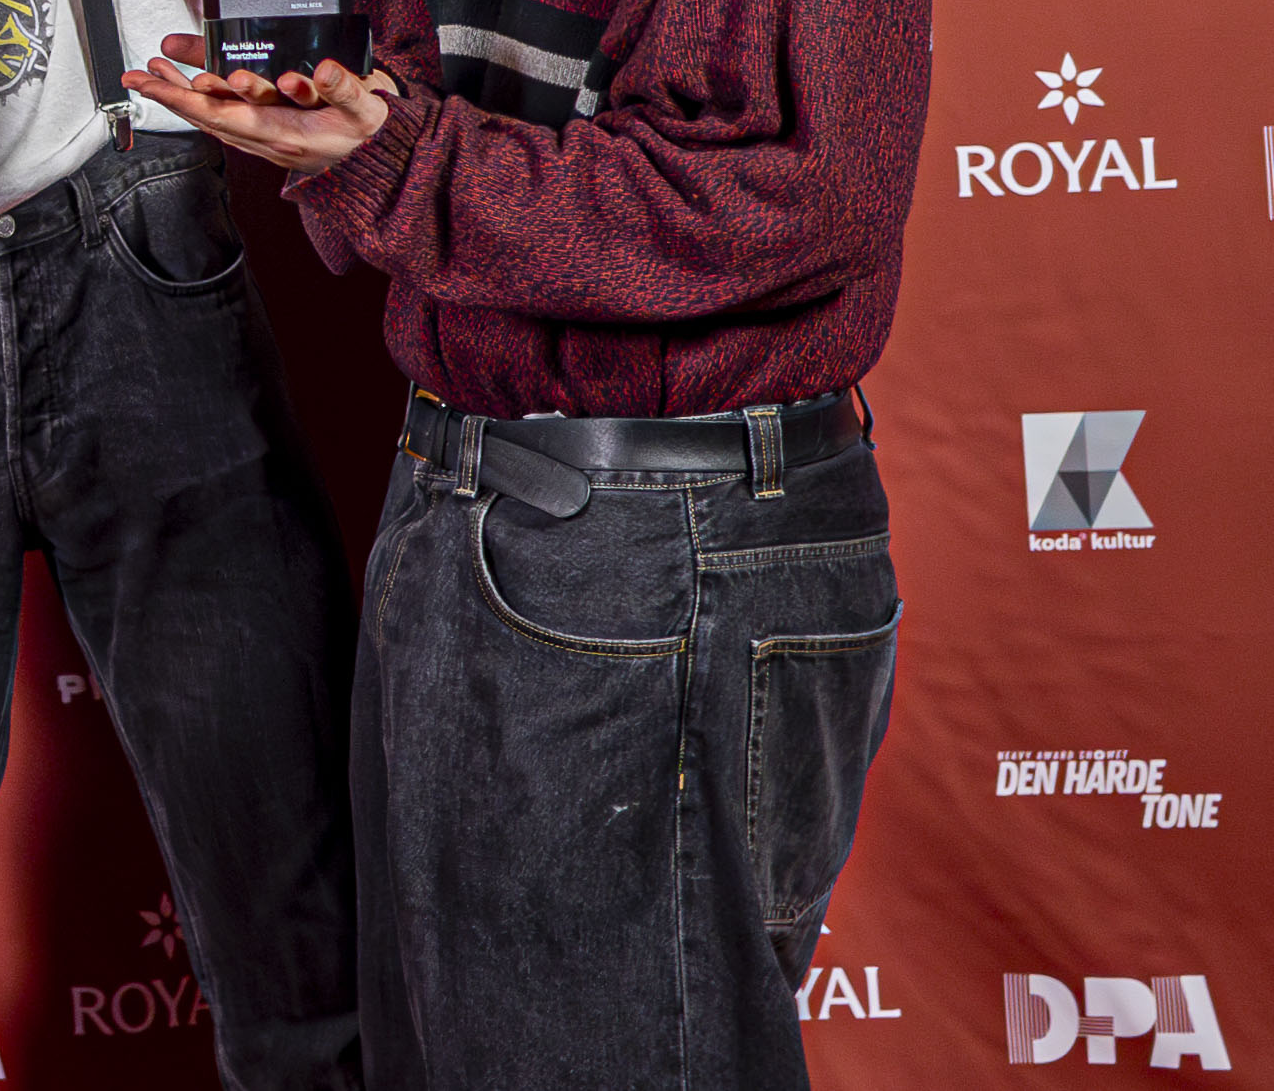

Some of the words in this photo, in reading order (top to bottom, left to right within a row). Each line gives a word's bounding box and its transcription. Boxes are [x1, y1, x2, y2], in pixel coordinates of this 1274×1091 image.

[955, 136, 1177, 198] ROYAL
[996, 760, 1059, 796] DEN
[1140, 793, 1223, 829] TONE
[1003, 972, 1231, 1070] DPA
